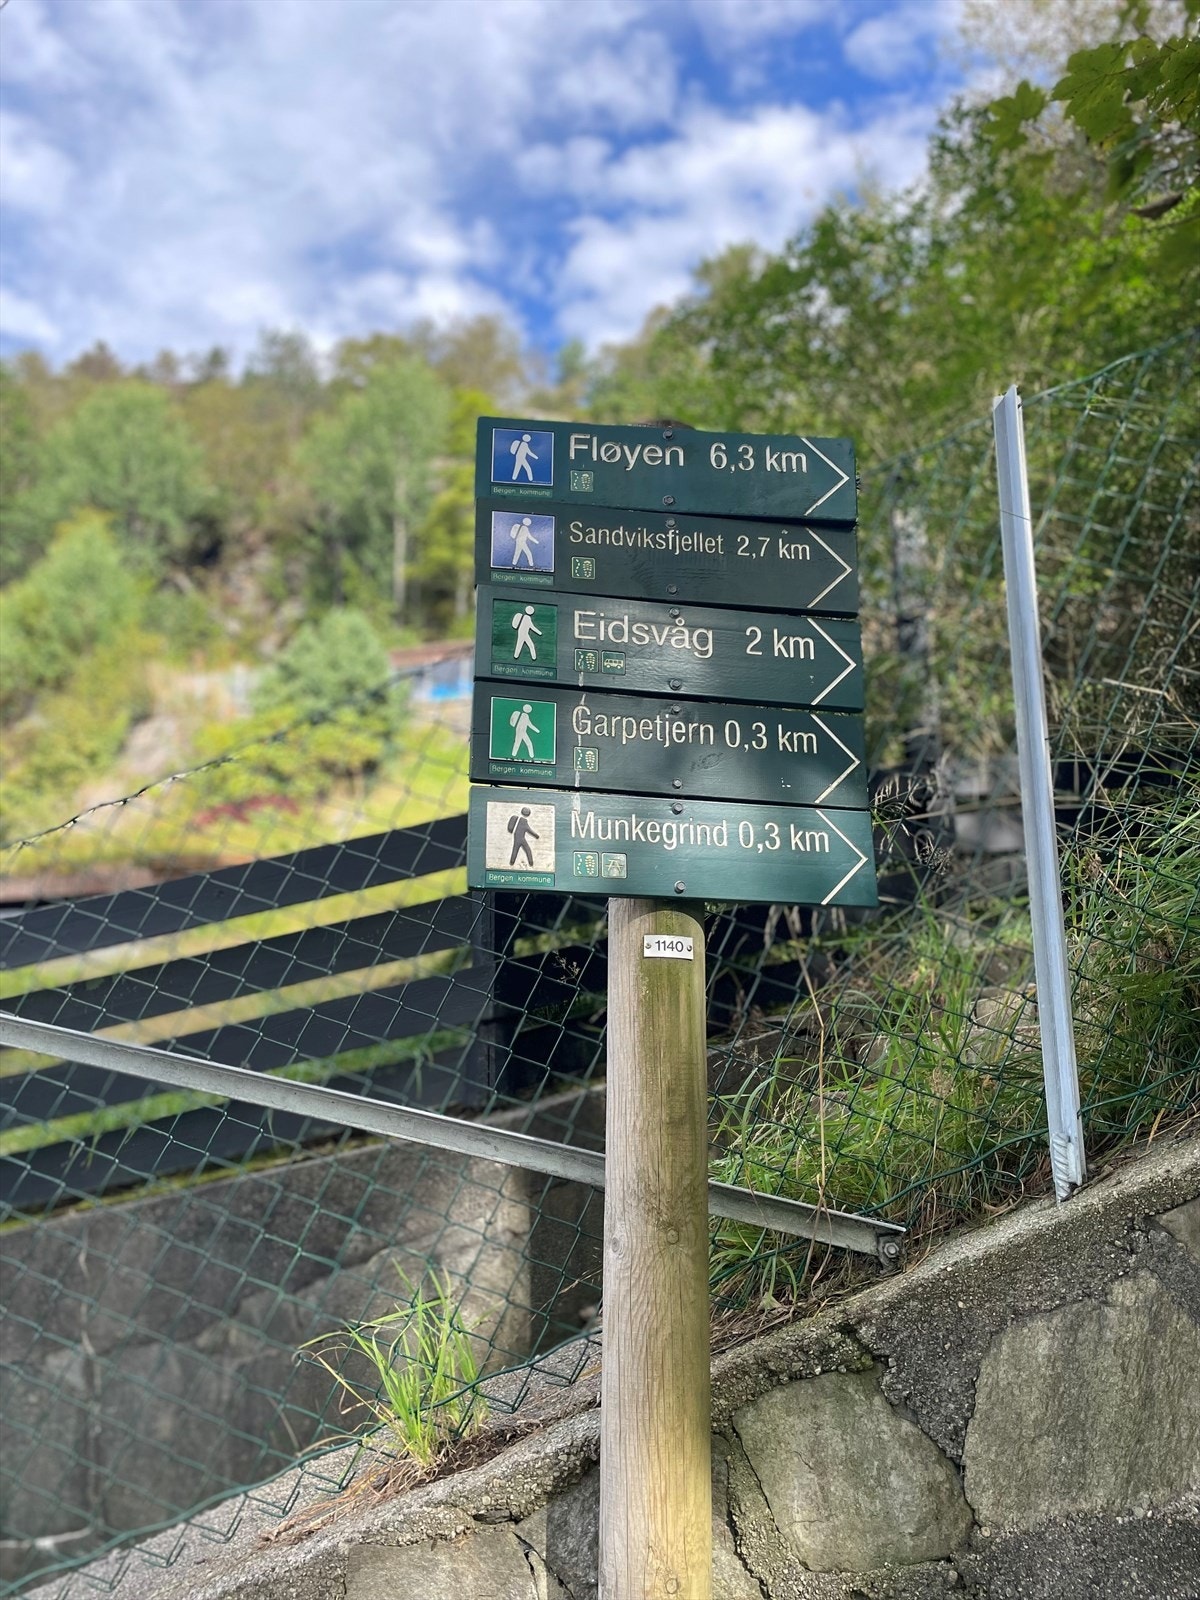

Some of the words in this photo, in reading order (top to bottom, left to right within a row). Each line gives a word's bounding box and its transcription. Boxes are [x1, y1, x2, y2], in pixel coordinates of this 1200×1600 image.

[569, 433, 685, 472] Fløyen
[709, 442, 755, 472] 6,3
[765, 446, 807, 472] km
[569, 521, 724, 555] Sandviksfjellet
[737, 536, 771, 559] 2,7
[779, 537, 811, 560] km
[573, 610, 714, 658] Eidsvåg
[745, 626, 763, 656] 2
[773, 628, 815, 660] km
[572, 706, 714, 747] Garpetjern
[724, 719, 768, 752] 0,3
[778, 726, 818, 754] km
[491, 764, 516, 774] Bergen
[520, 767, 553, 776] kommune
[571, 811, 728, 850] Munkegrind
[738, 821, 780, 854] 0,3
[790, 824, 830, 853] km
[488, 873, 514, 883] Bergen
[517, 874, 552, 883] kommune
[655, 940, 684, 953] 1140
